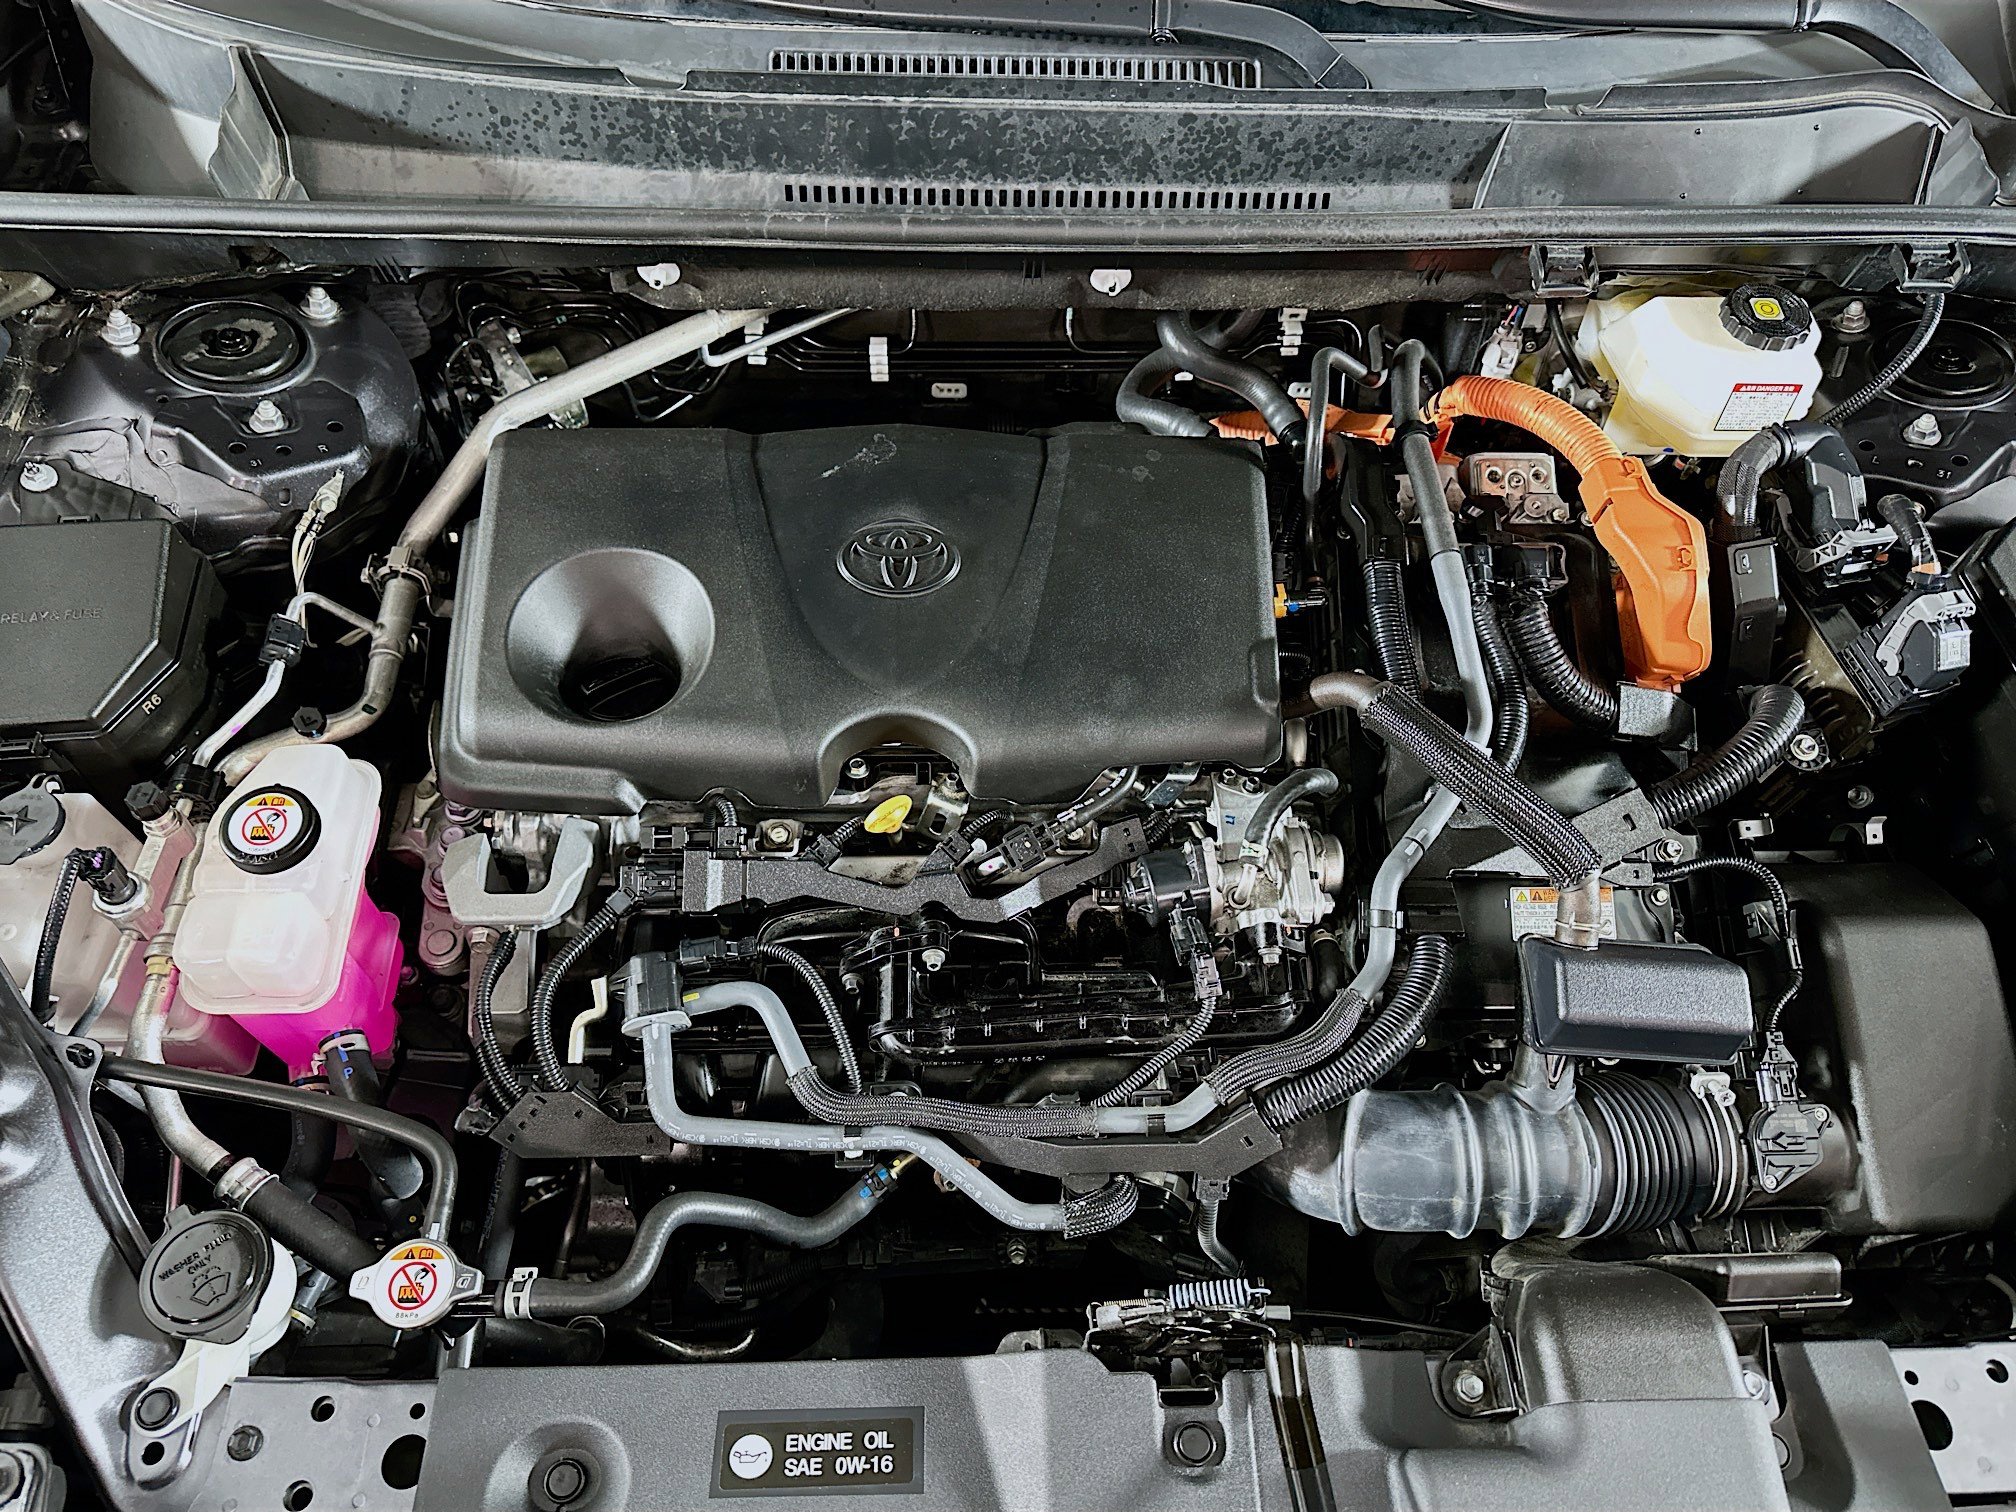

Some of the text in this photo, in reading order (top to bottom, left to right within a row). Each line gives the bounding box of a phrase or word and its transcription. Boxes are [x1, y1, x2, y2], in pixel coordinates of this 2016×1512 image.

[0, 611, 50, 624] RELAY
[64, 608, 102, 620] FUSE
[141, 693, 163, 715] R6
[159, 1252, 201, 1281] WASHER
[187, 1254, 212, 1275] ONLY
[785, 1431, 895, 1452] ENGINE OIL
[784, 1455, 894, 1477] SAE 0W-16
